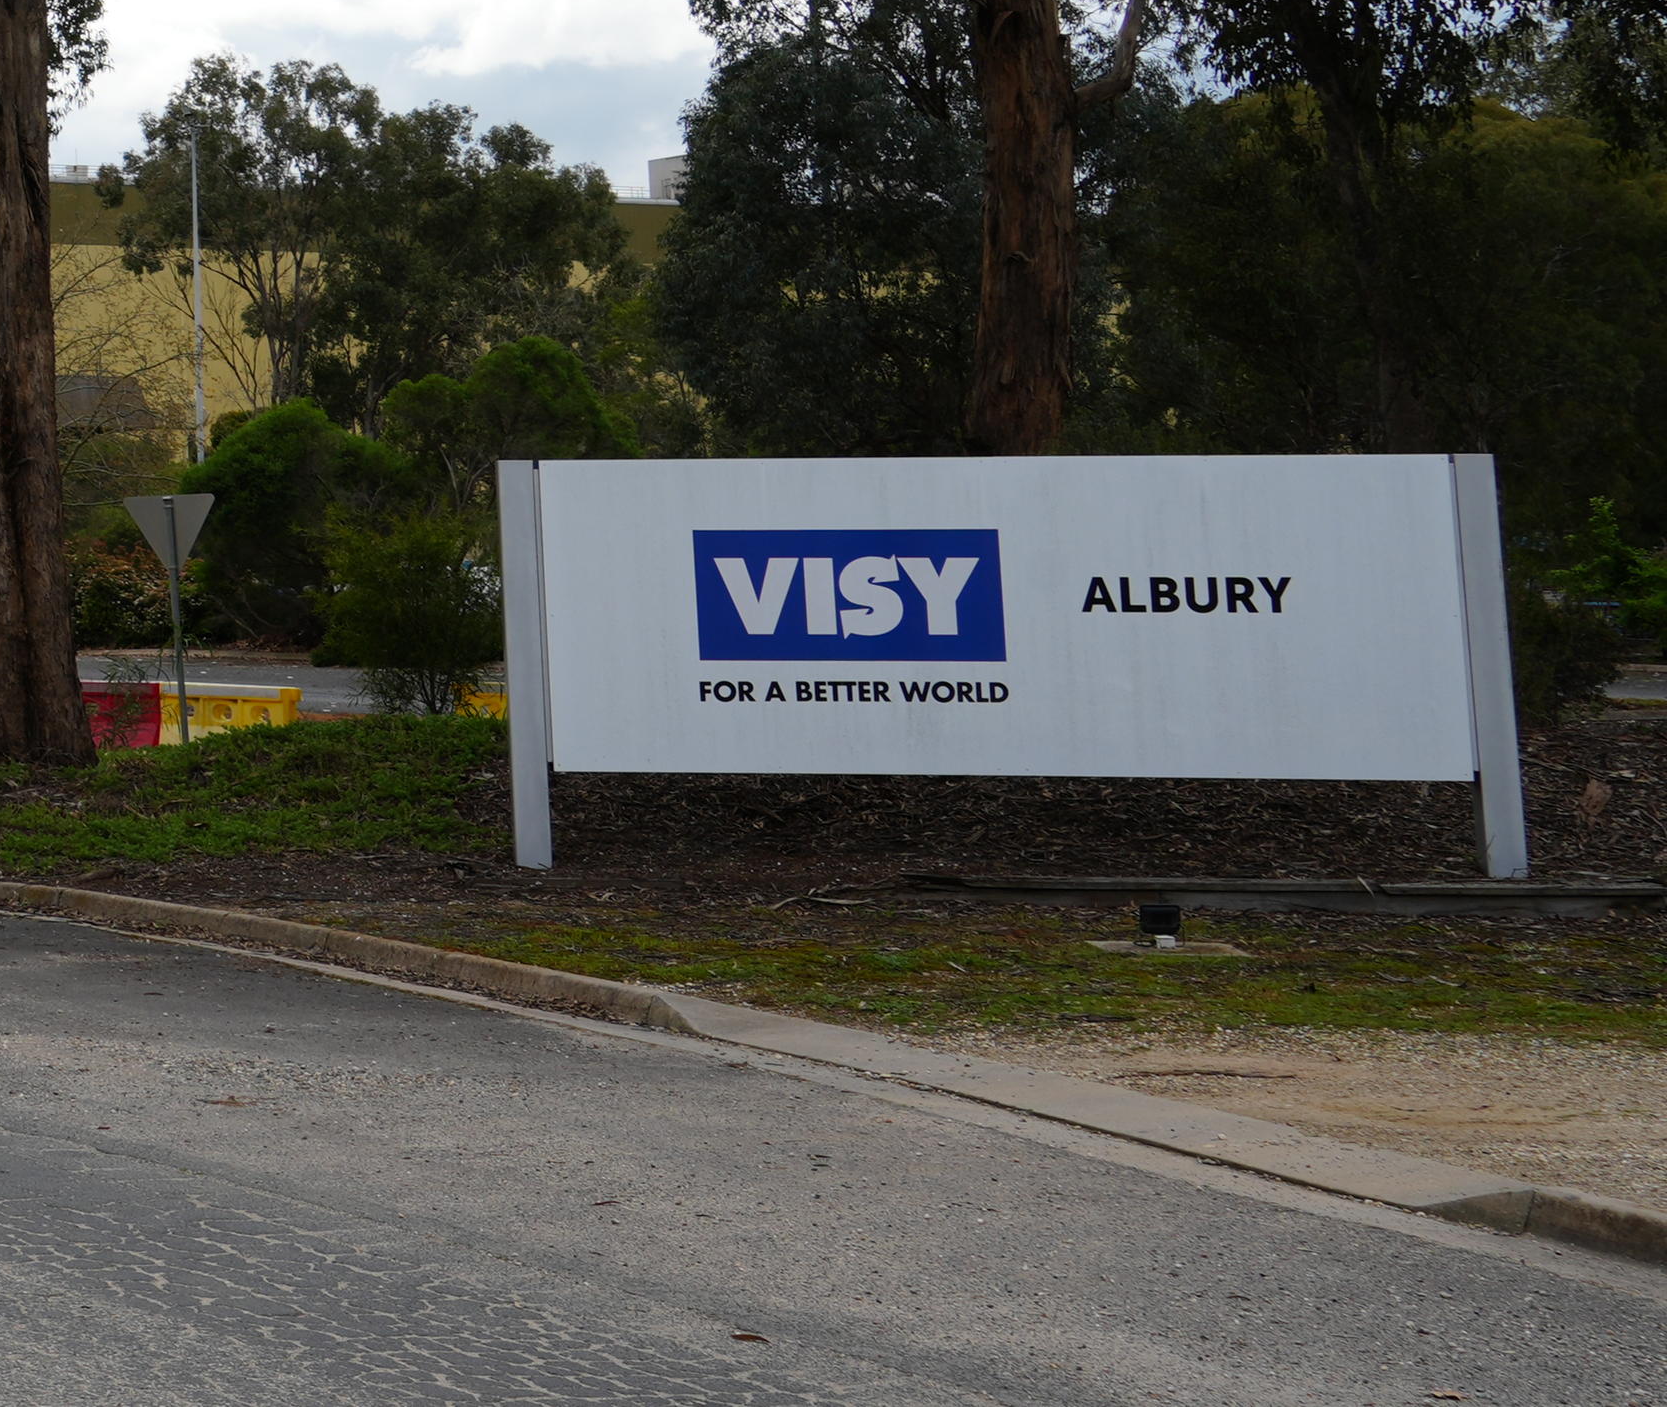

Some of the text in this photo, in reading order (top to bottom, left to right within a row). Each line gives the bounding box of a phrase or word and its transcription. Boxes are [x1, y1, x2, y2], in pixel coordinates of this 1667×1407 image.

[713, 554, 980, 640] VISY
[1082, 576, 1291, 613] ALBURY
[699, 681, 1009, 703] FOR A BETTER WORLD
